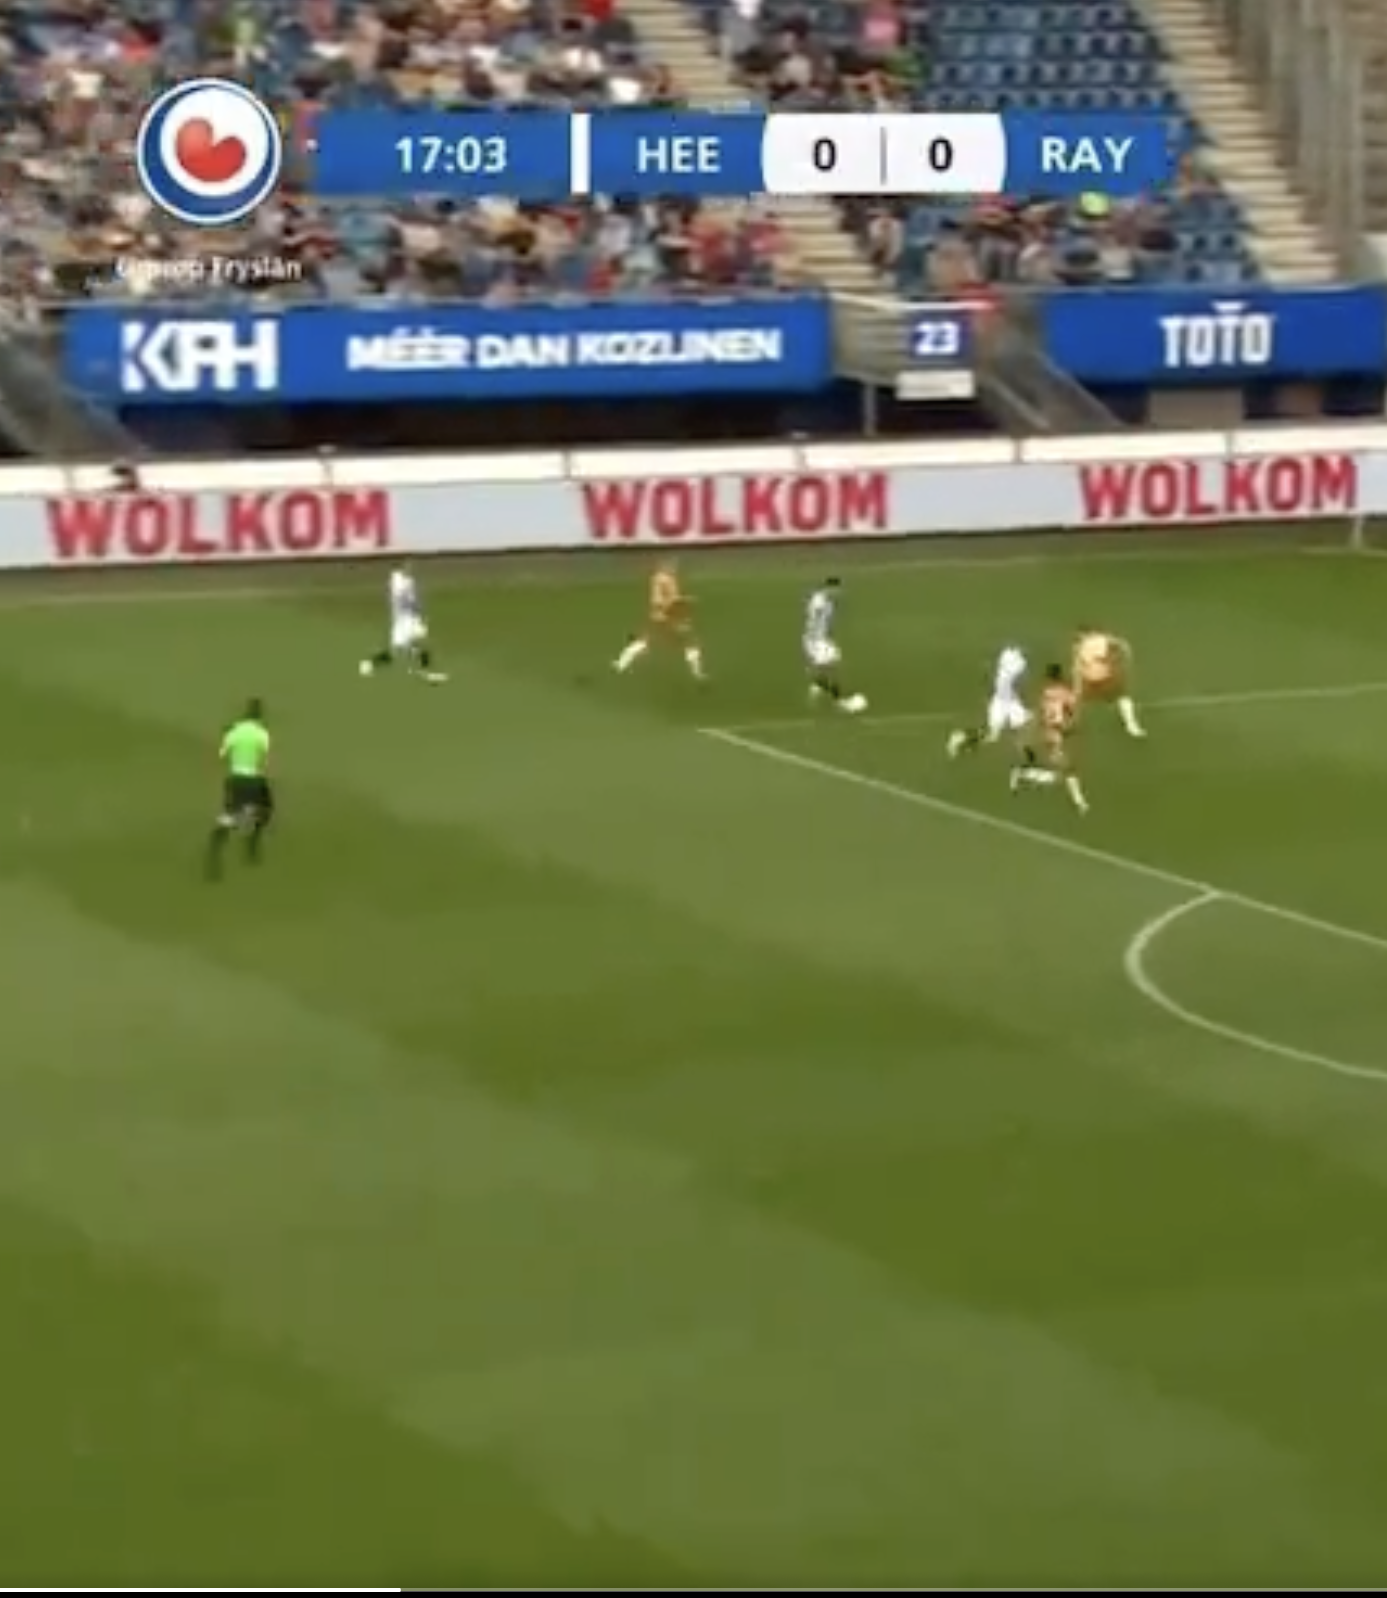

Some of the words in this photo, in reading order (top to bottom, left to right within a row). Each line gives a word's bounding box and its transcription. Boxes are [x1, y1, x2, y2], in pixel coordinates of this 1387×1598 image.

[475, 335, 571, 368] DAN
[915, 320, 960, 355] 23
[581, 471, 888, 540] WOLKOM
[1078, 454, 1359, 520] WOLKOM
[46, 489, 391, 559] WOLKOM
